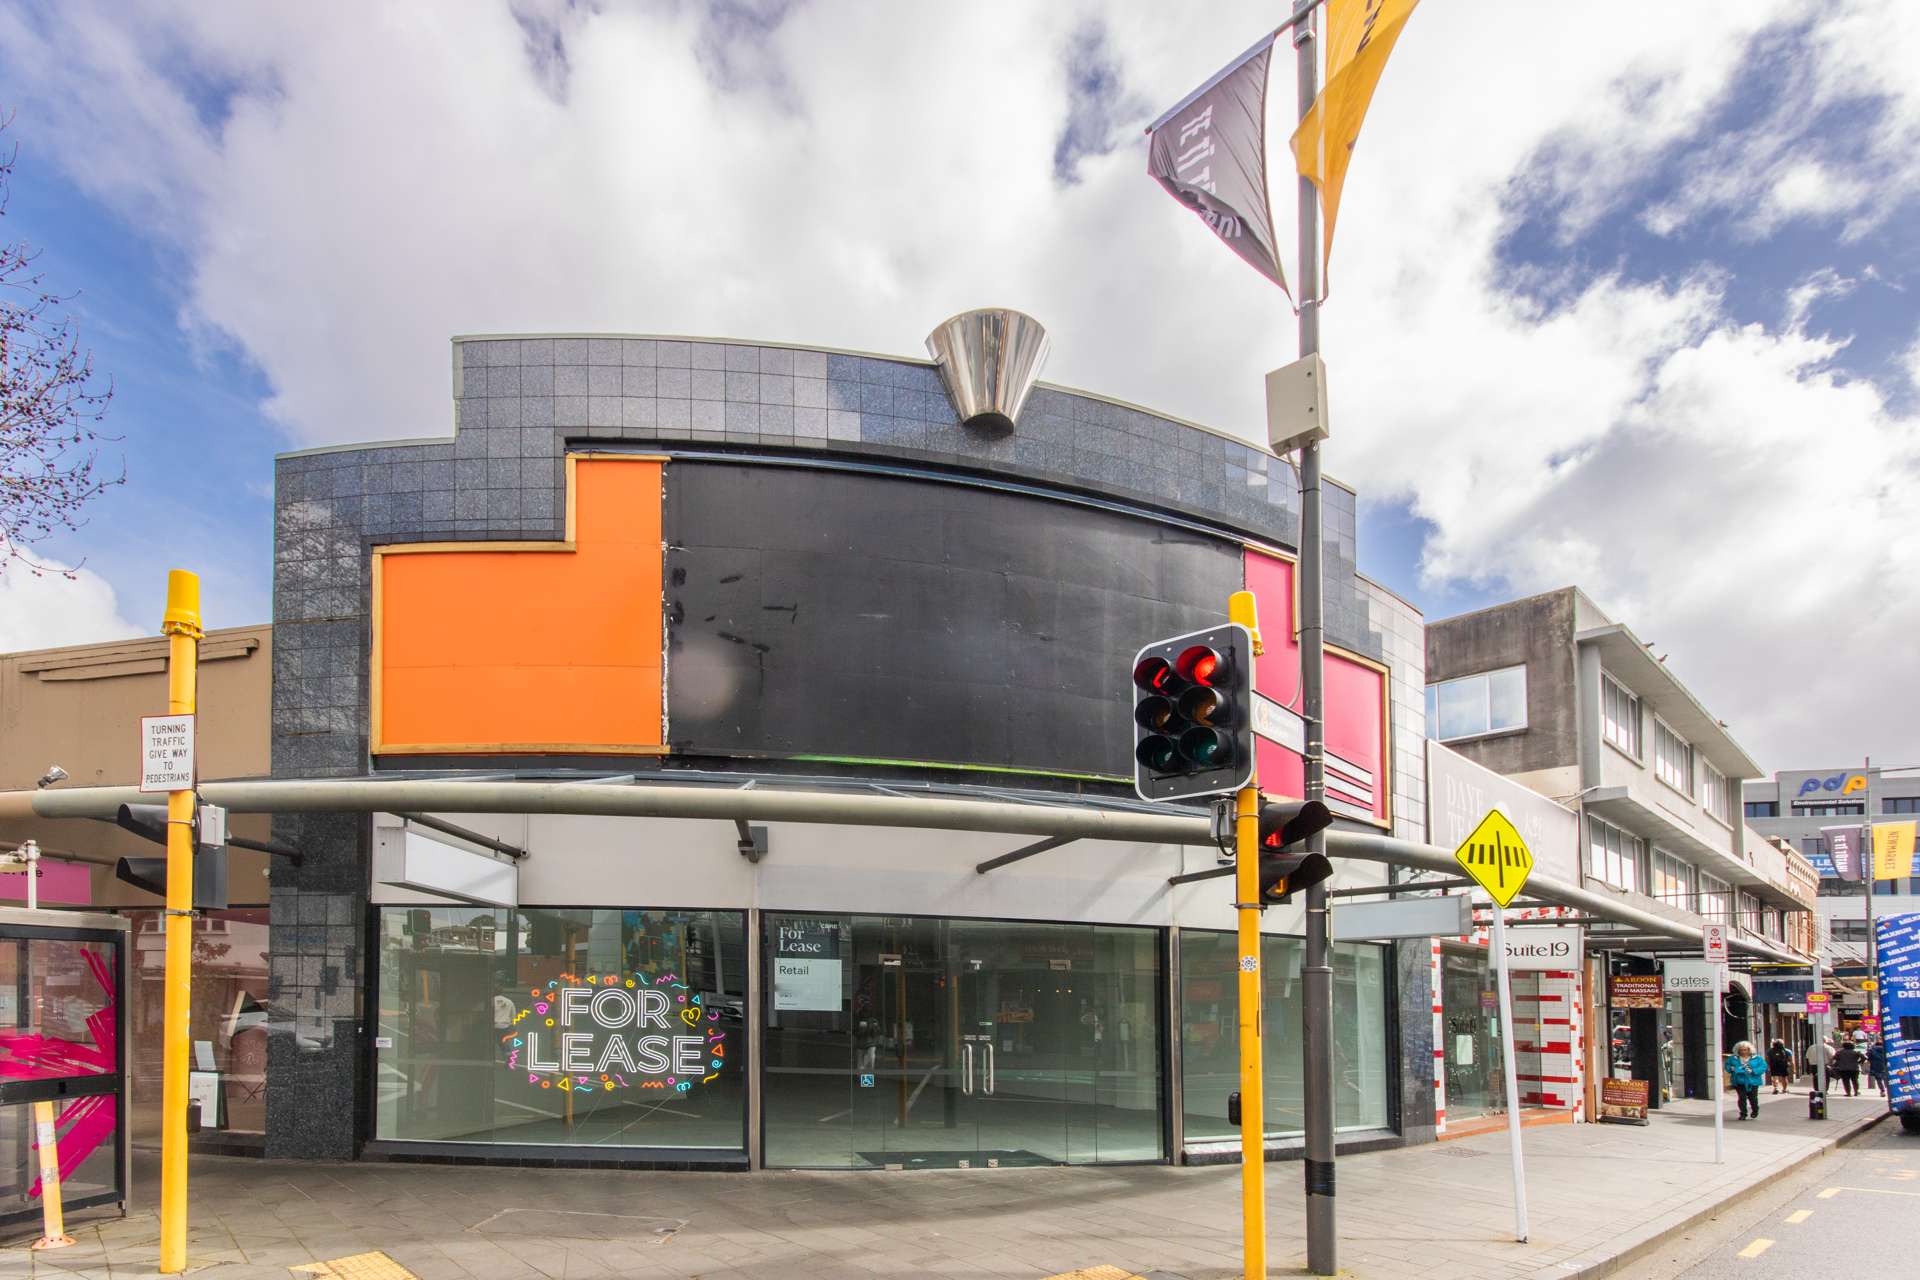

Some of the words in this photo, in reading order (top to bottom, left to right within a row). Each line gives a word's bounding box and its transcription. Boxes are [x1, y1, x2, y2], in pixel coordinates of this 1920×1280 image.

[151, 724, 186, 735] TURNING
[151, 736, 186, 747] TRAFFIC
[149, 749, 168, 760] GIVE
[171, 748, 188, 758] WAY
[163, 761, 174, 771] TO
[145, 772, 190, 784] PEDESTRIANS
[1797, 772, 1867, 797] pdp
[779, 926, 805, 940] For
[779, 939, 822, 953] Lease
[779, 965, 809, 976] Retail
[1670, 976, 1711, 988] gates
[561, 987, 672, 1029] FOR
[527, 1031, 705, 1075] LEASE
